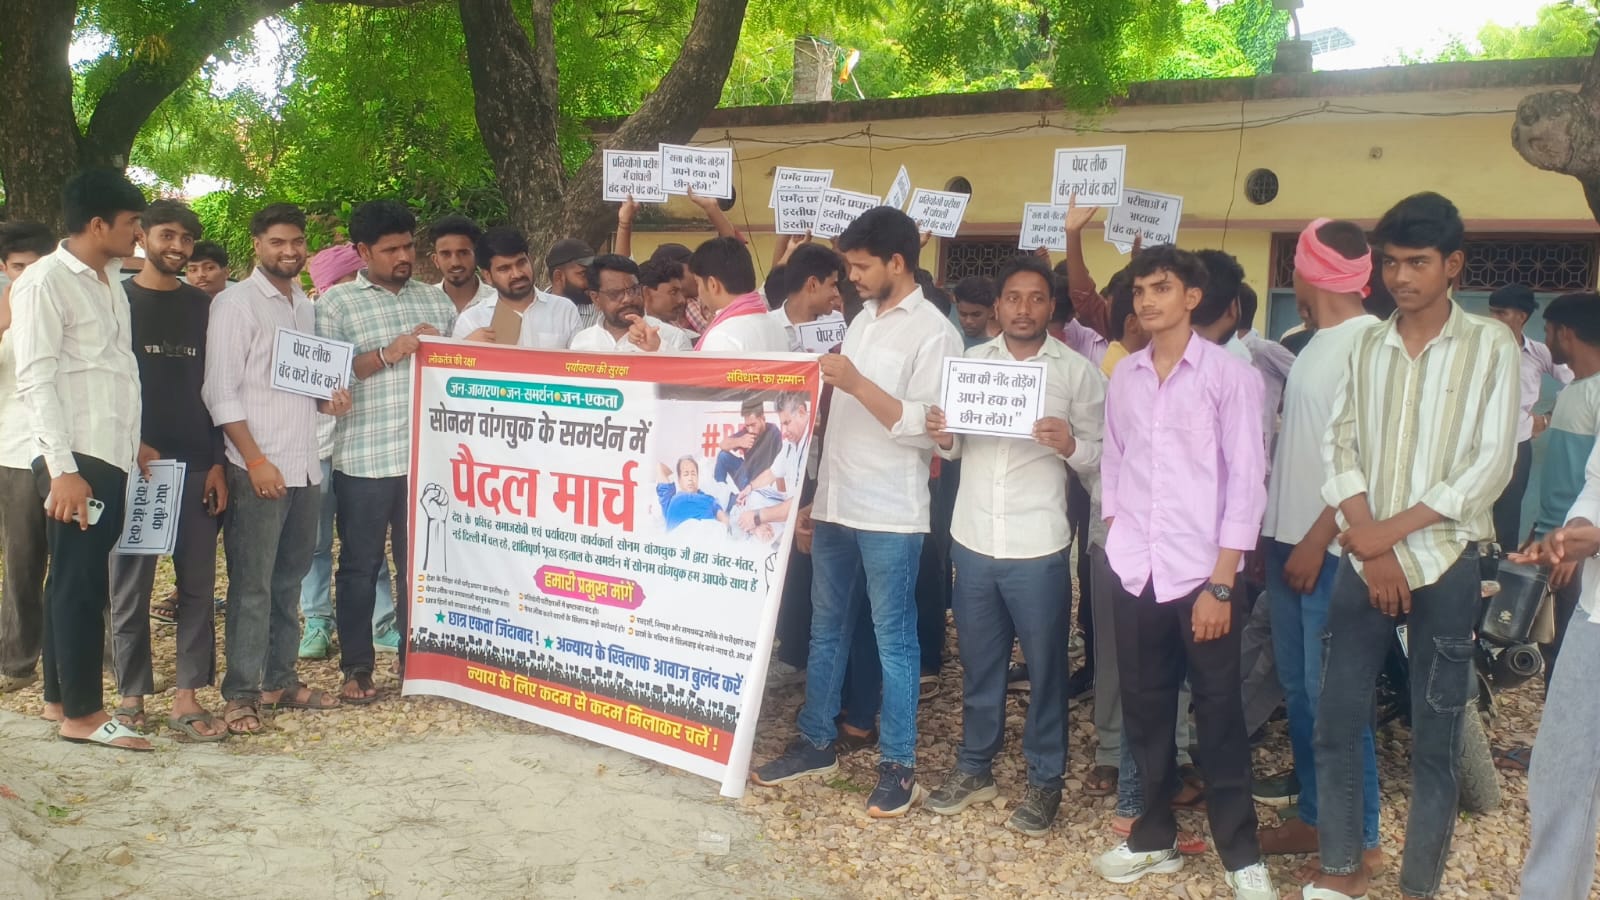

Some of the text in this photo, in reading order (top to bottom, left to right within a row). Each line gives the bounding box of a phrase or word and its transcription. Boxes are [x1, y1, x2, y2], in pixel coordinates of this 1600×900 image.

[643, 157, 659, 168] परी
[1072, 154, 1108, 172] पेपर लीक
[671, 167, 719, 179] अपने हक को
[609, 182, 619, 192] बंद
[620, 183, 634, 194] करो
[1059, 178, 1117, 196] बंद करो बंद करो
[783, 207, 816, 217] इस्तीफ
[1113, 224, 1123, 233] बंद
[1144, 229, 1153, 239] बंद
[816, 324, 845, 343] पेपर ली
[293, 339, 331, 363] पेपर लीक
[278, 361, 341, 390] बंद करो बंद करो
[596, 362, 606, 375] की
[608, 365, 630, 378] सुरक्षा
[726, 369, 806, 385] संविधान का सम्मान
[978, 371, 1036, 390] की नींद तोड़ेंगे
[560, 392, 618, 409] जन-एकता
[957, 392, 1026, 408] अपने हक को
[960, 409, 982, 424] छीन
[429, 402, 653, 454] सोनम वांगचुक के समर्थन में
[134, 486, 150, 506] करो
[449, 443, 639, 532] पैदल मार्च
[130, 508, 147, 522] बंद
[152, 484, 170, 530] पेपर लीक
[128, 524, 143, 544] करो
[452, 512, 462, 523] देश
[465, 514, 471, 524] के
[531, 526, 542, 537] एवं
[545, 527, 577, 543] पर्यावरण
[580, 532, 613, 548] कार्यकर्ता
[616, 538, 640, 553] सोनम
[644, 542, 676, 560] वांगचुक
[680, 546, 690, 560] जी
[693, 550, 708, 564] द्वारा
[452, 530, 461, 540] नई
[462, 530, 479, 544] दिल्ली
[488, 537, 499, 547] चल
[559, 549, 583, 562] हड़ताल
[585, 551, 593, 564] के
[595, 554, 621, 568] समर्थन
[632, 560, 655, 574] सोनम
[658, 564, 687, 582] वांगचुक
[687, 570, 700, 582] हम
[702, 573, 728, 587] आपके
[730, 577, 748, 591] साथ
[544, 571, 576, 591] हमारी
[578, 578, 608, 600] प्रमुख
[448, 611, 466, 628] छात्र
[468, 615, 493, 635] एकता
[495, 618, 534, 644] जिंदाबाद
[556, 636, 743, 695] अन्याय के खिलाफ आवाज बुलंद करें
[467, 665, 496, 687] न्याय
[498, 669, 510, 689] के
[513, 674, 537, 698] लिए
[539, 685, 571, 707] कदम
[574, 690, 587, 711] से
[589, 698, 623, 722] कदम
[625, 705, 682, 740] मिलाकर
[684, 724, 710, 748] चलें
